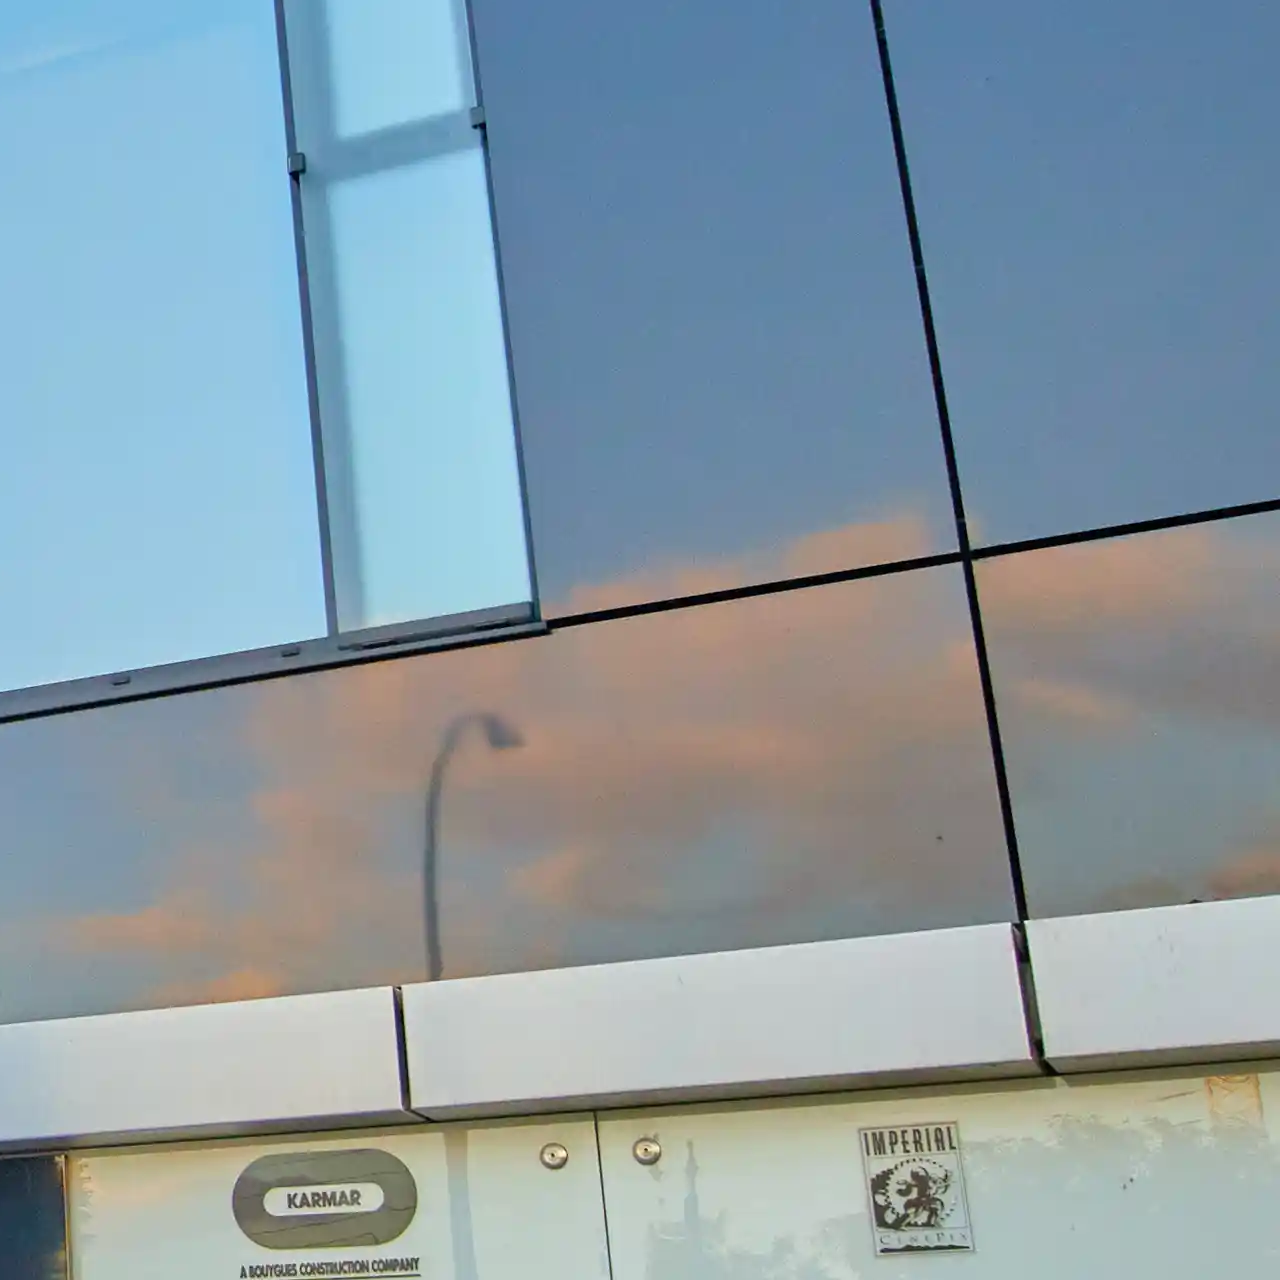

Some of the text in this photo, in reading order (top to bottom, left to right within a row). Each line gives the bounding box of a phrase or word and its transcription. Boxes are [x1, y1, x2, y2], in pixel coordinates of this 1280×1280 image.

[863, 1125, 957, 1156] IMPERIAL
[287, 1190, 362, 1210] KARMAR
[240, 1256, 420, 1279] A BOUYGUES CONSTRUCTION COMPANY
